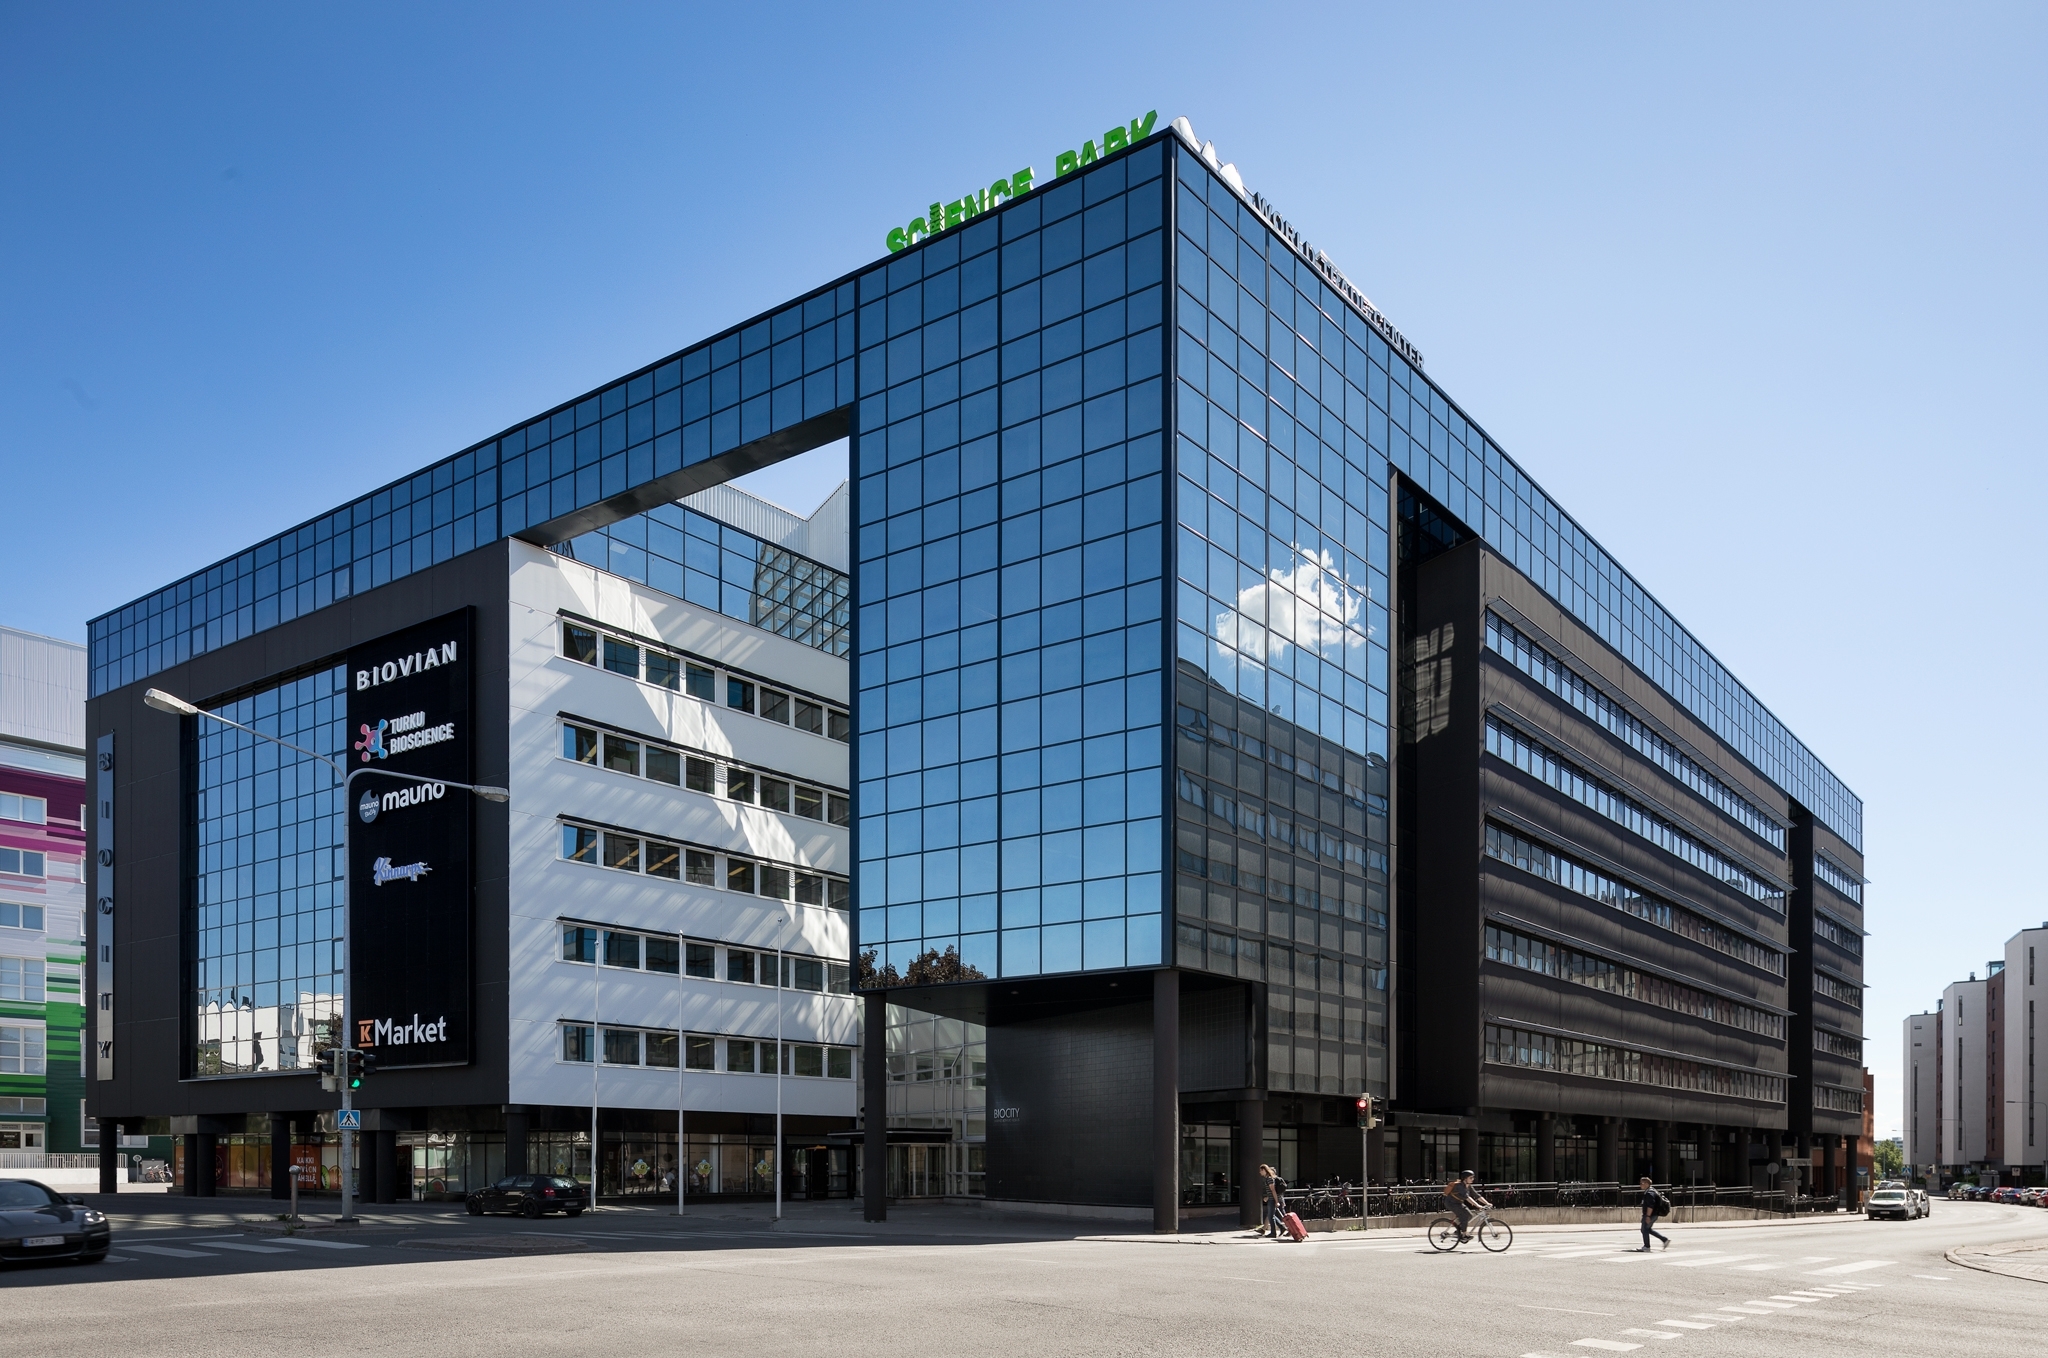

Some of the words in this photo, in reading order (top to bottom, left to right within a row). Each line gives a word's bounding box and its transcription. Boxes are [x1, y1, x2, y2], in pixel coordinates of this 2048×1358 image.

[1056, 110, 1158, 178] PARK
[1252, 191, 1315, 264] WORLD
[1315, 256, 1369, 315] TRADE
[1371, 309, 1425, 370] CENTER
[356, 640, 457, 691] BIOVIAN
[390, 711, 426, 735] TURKU
[390, 722, 455, 755] BIOSCIENCE
[360, 801, 379, 810] mauno
[382, 782, 446, 811] mauno
[993, 1107, 1020, 1119] BIOCITY
[297, 1173, 316, 1182] ÄHELLÄ
